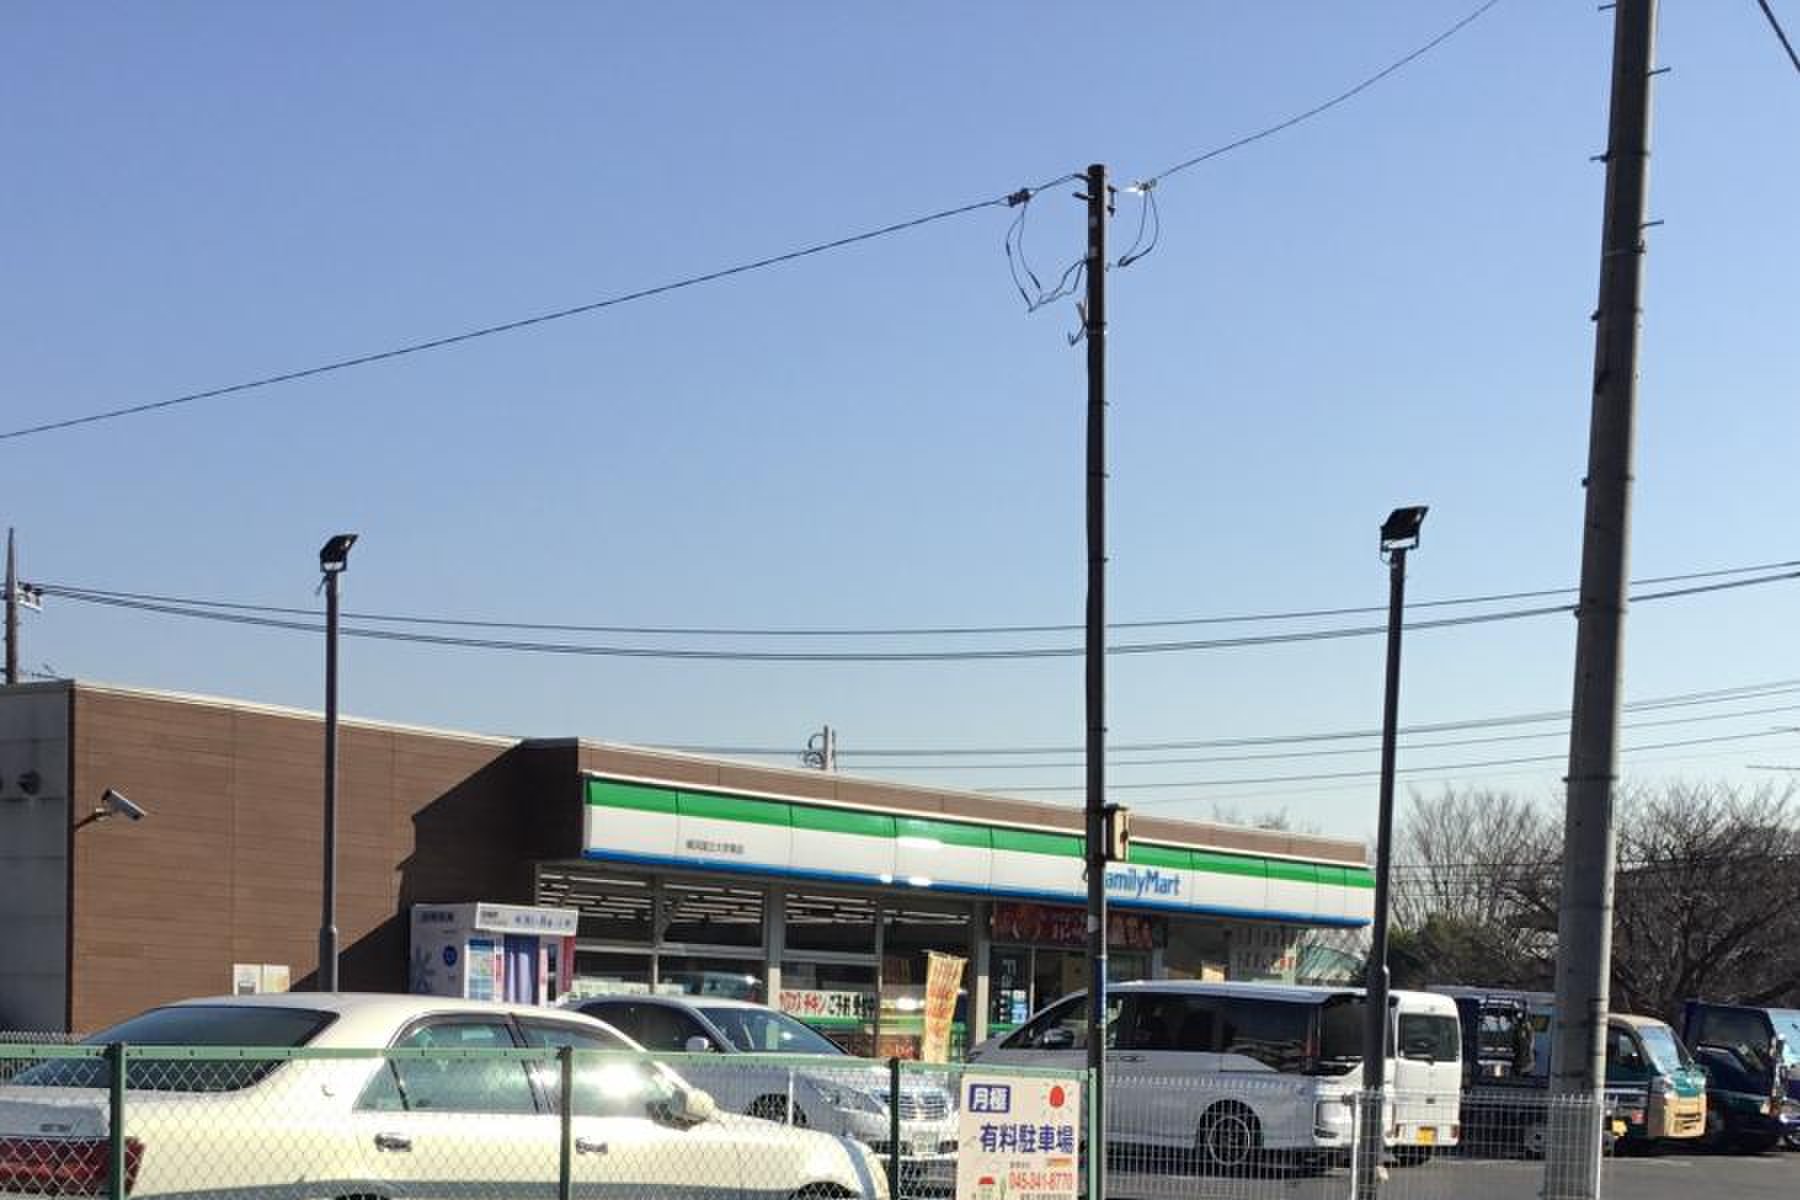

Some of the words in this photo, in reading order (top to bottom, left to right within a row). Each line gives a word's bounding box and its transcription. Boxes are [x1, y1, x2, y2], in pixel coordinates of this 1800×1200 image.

[1103, 867, 1181, 897] amilyMart
[972, 1087, 1008, 1111] 月極
[980, 1121, 1074, 1154] 有料駐車場
